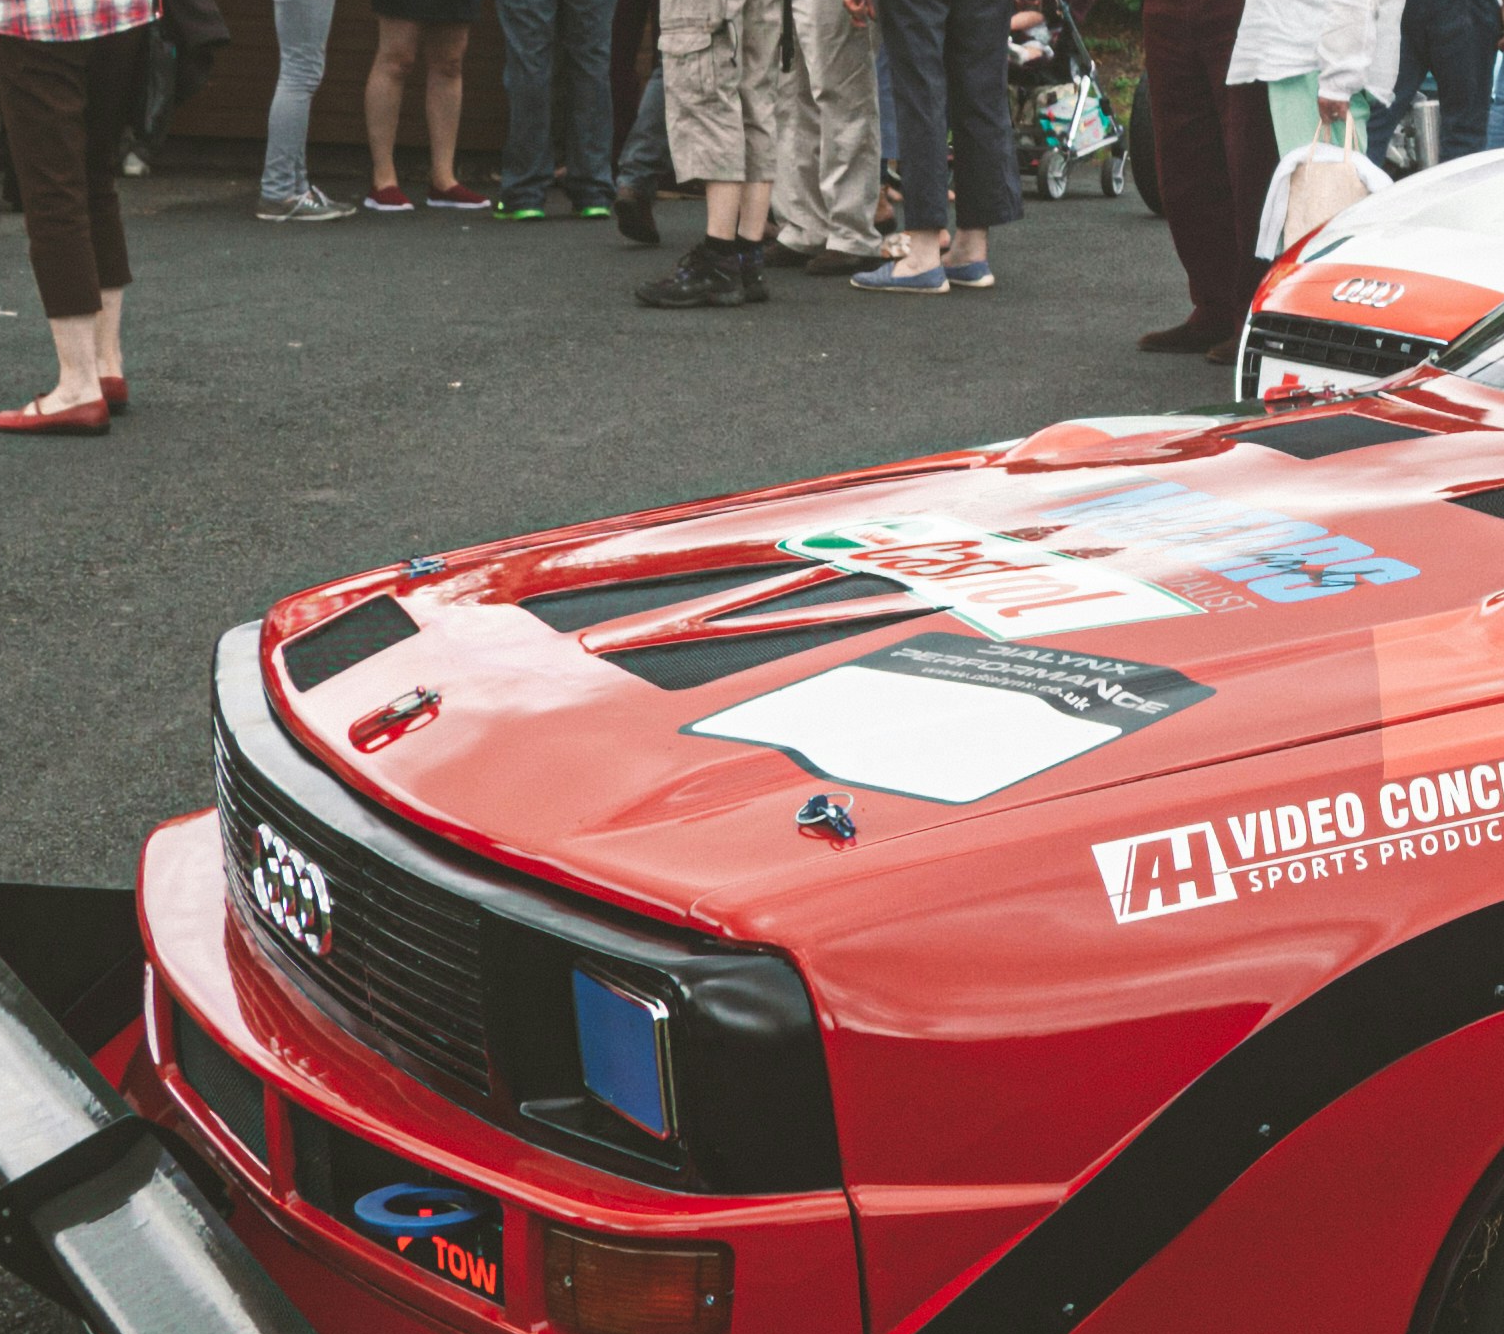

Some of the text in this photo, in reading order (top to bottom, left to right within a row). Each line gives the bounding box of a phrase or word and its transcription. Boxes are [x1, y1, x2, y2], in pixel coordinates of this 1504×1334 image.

[890, 647, 1170, 715] PERFORMANCE
[976, 644, 1140, 676] DIALYNX
[1226, 791, 1366, 861] VIDEO
[1248, 848, 1369, 893] SPORTS
[431, 1235, 497, 1295] TOW
